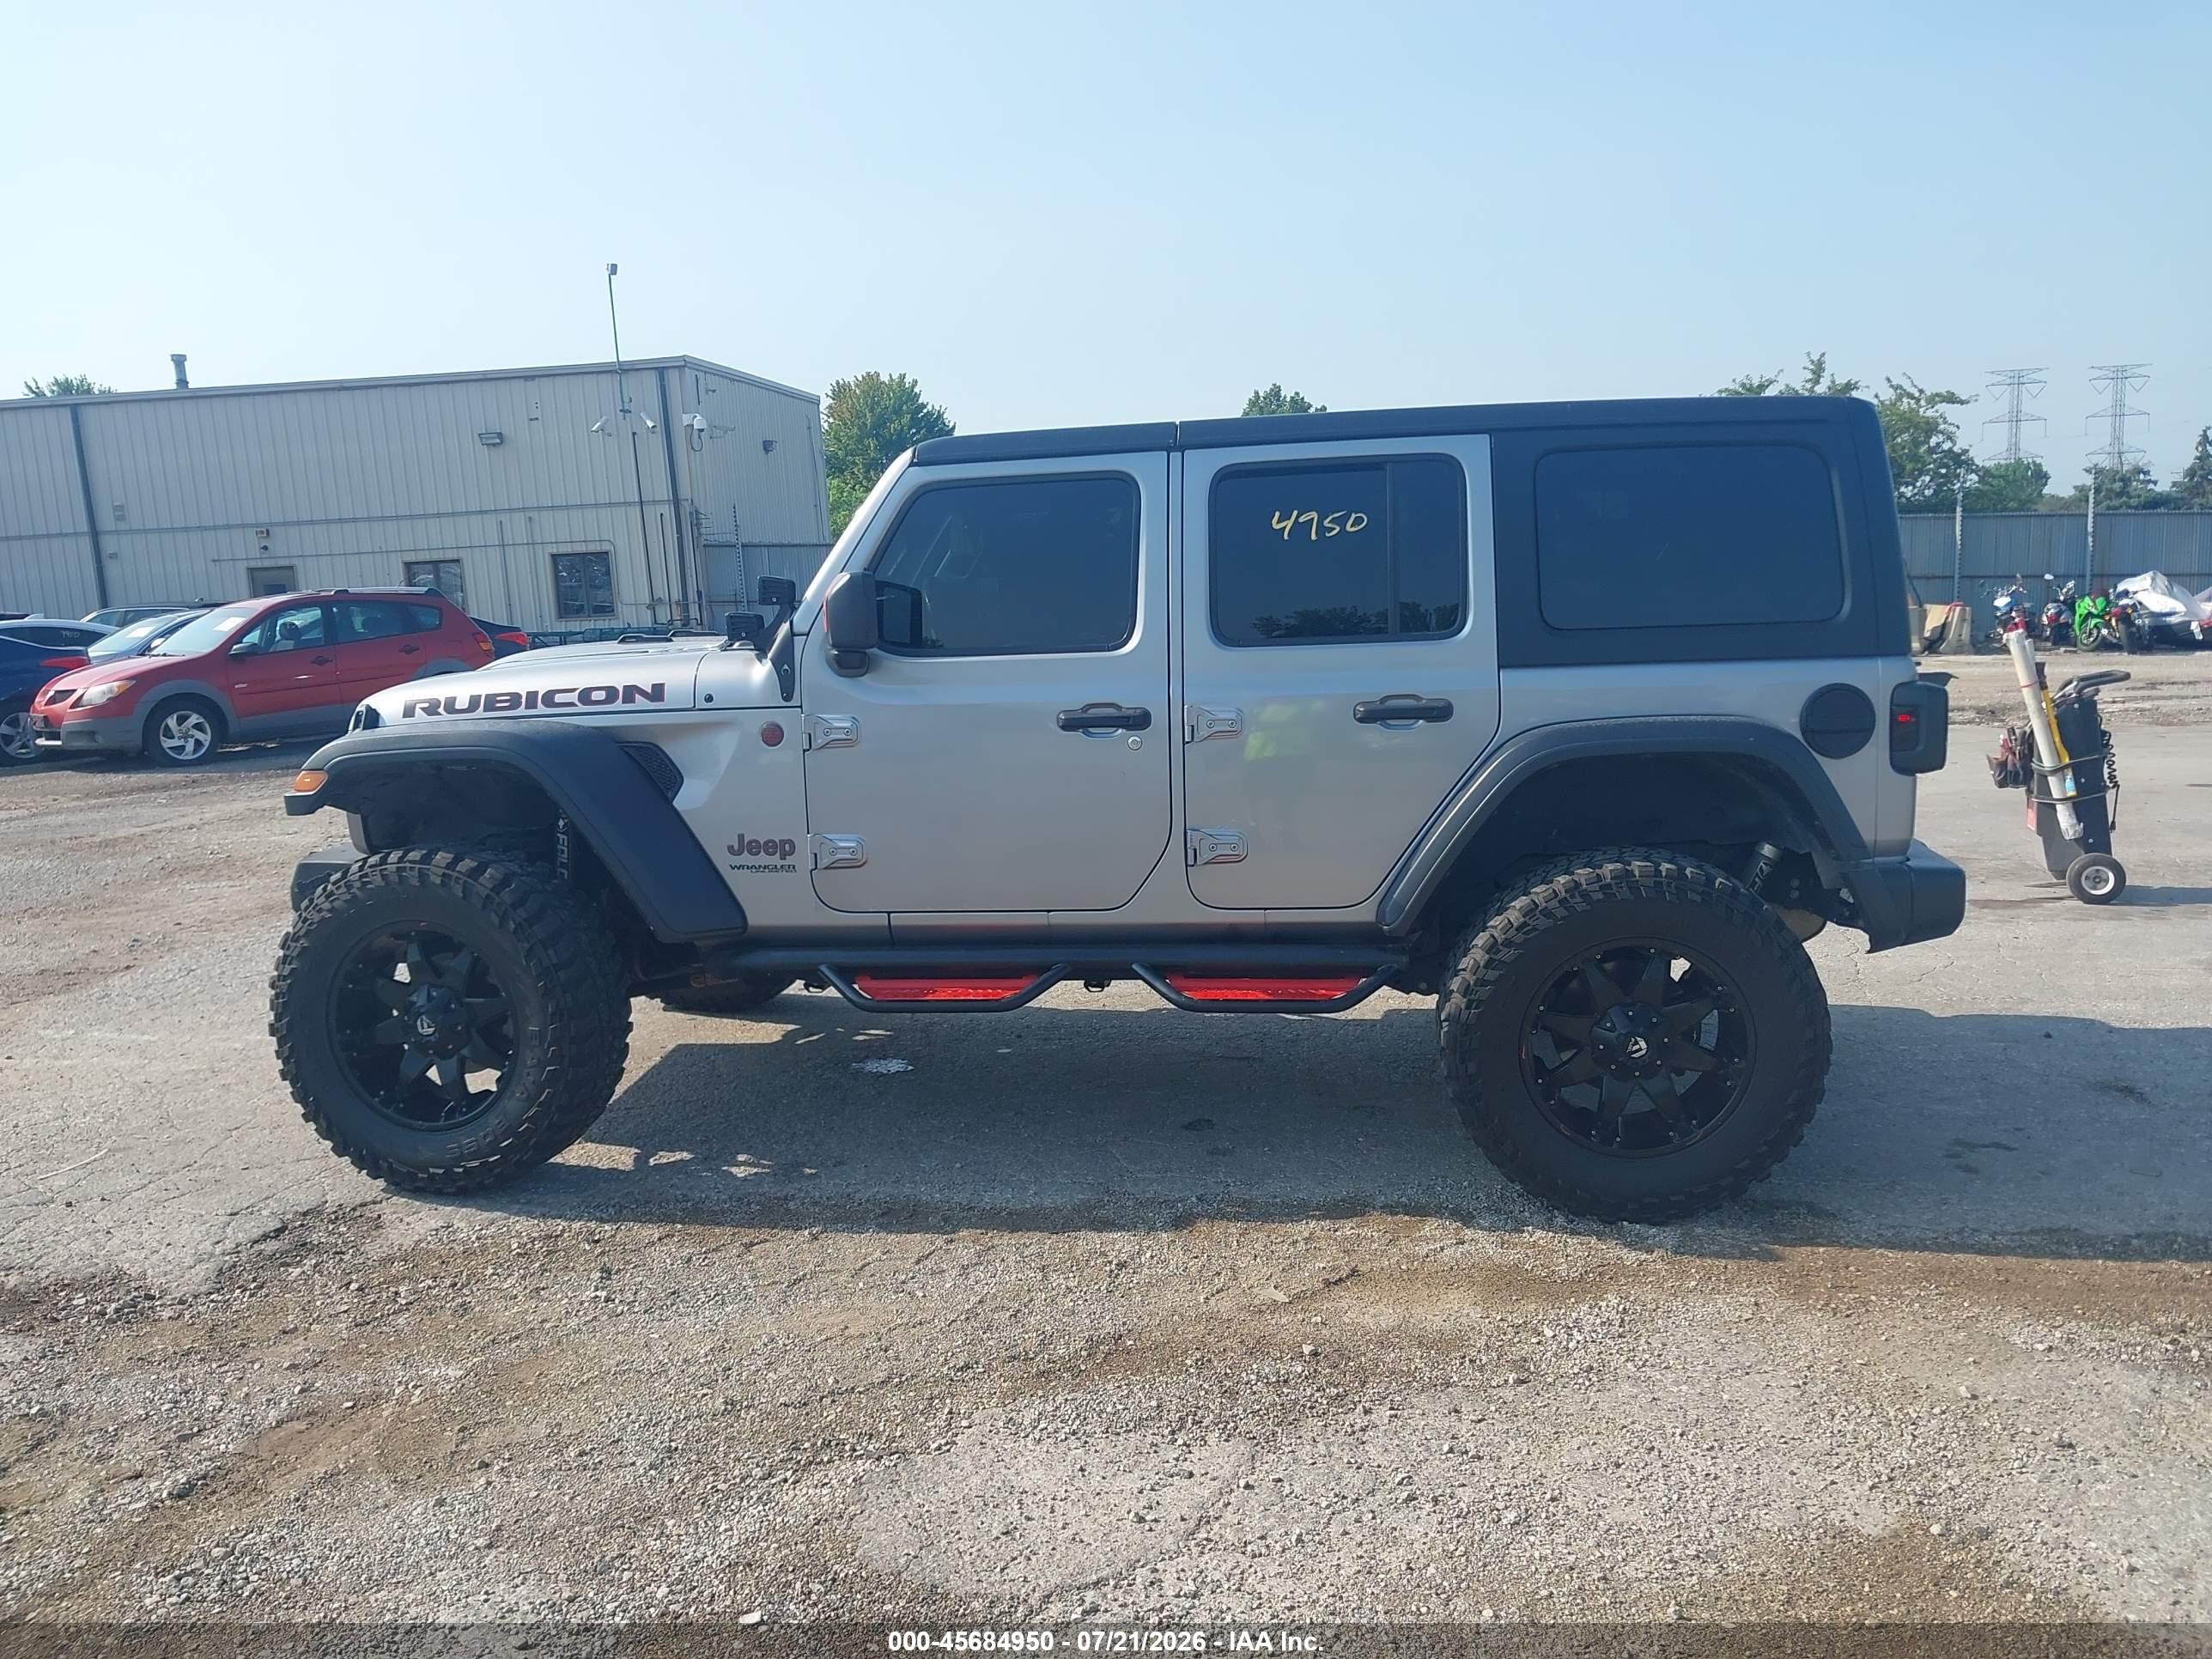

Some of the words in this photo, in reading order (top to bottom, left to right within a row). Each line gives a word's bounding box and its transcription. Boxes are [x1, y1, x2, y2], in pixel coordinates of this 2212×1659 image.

[1271, 509, 1368, 540] 4950
[402, 682, 665, 719] RUBICON
[726, 833, 796, 860] Jeep
